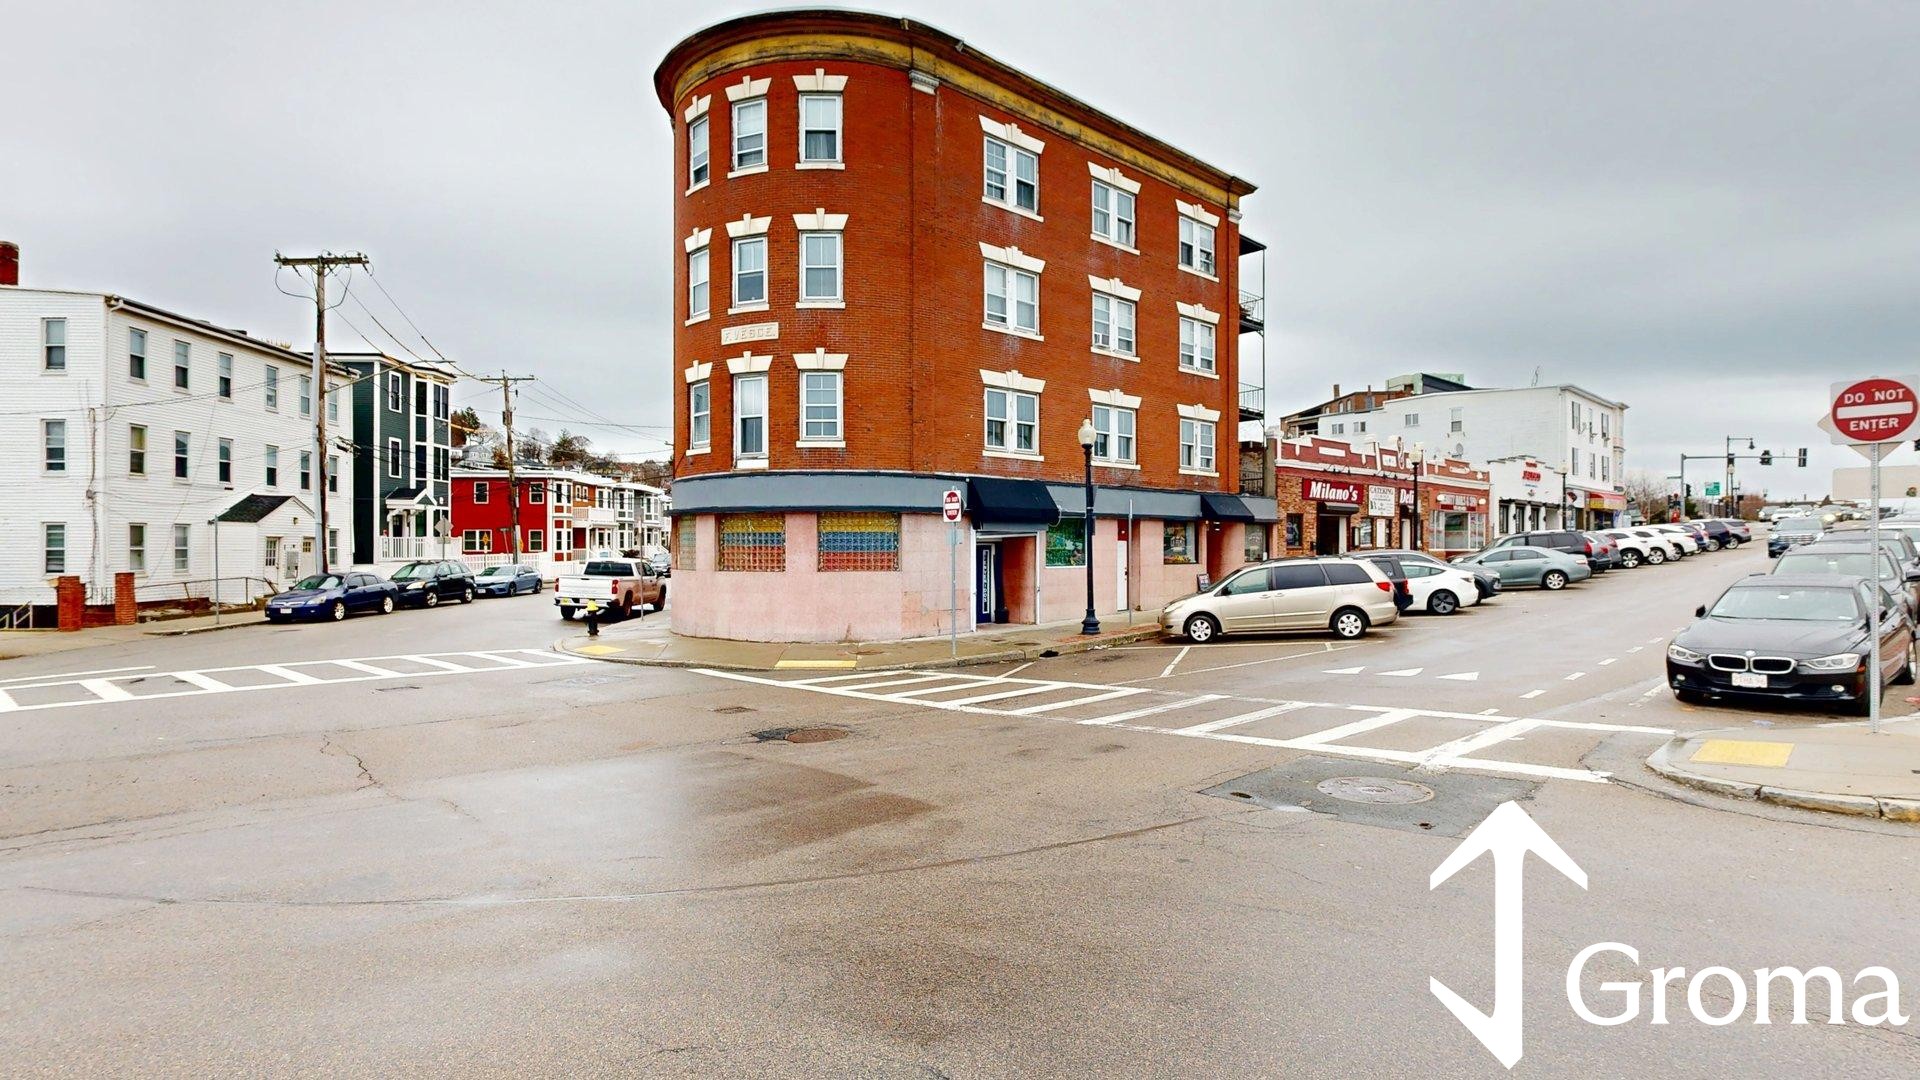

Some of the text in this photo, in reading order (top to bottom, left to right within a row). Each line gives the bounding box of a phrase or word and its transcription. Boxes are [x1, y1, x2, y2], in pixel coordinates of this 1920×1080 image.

[1844, 388, 1905, 404] DO NOT
[1849, 418, 1899, 431] ENTER
[1309, 481, 1358, 501] Milano's
